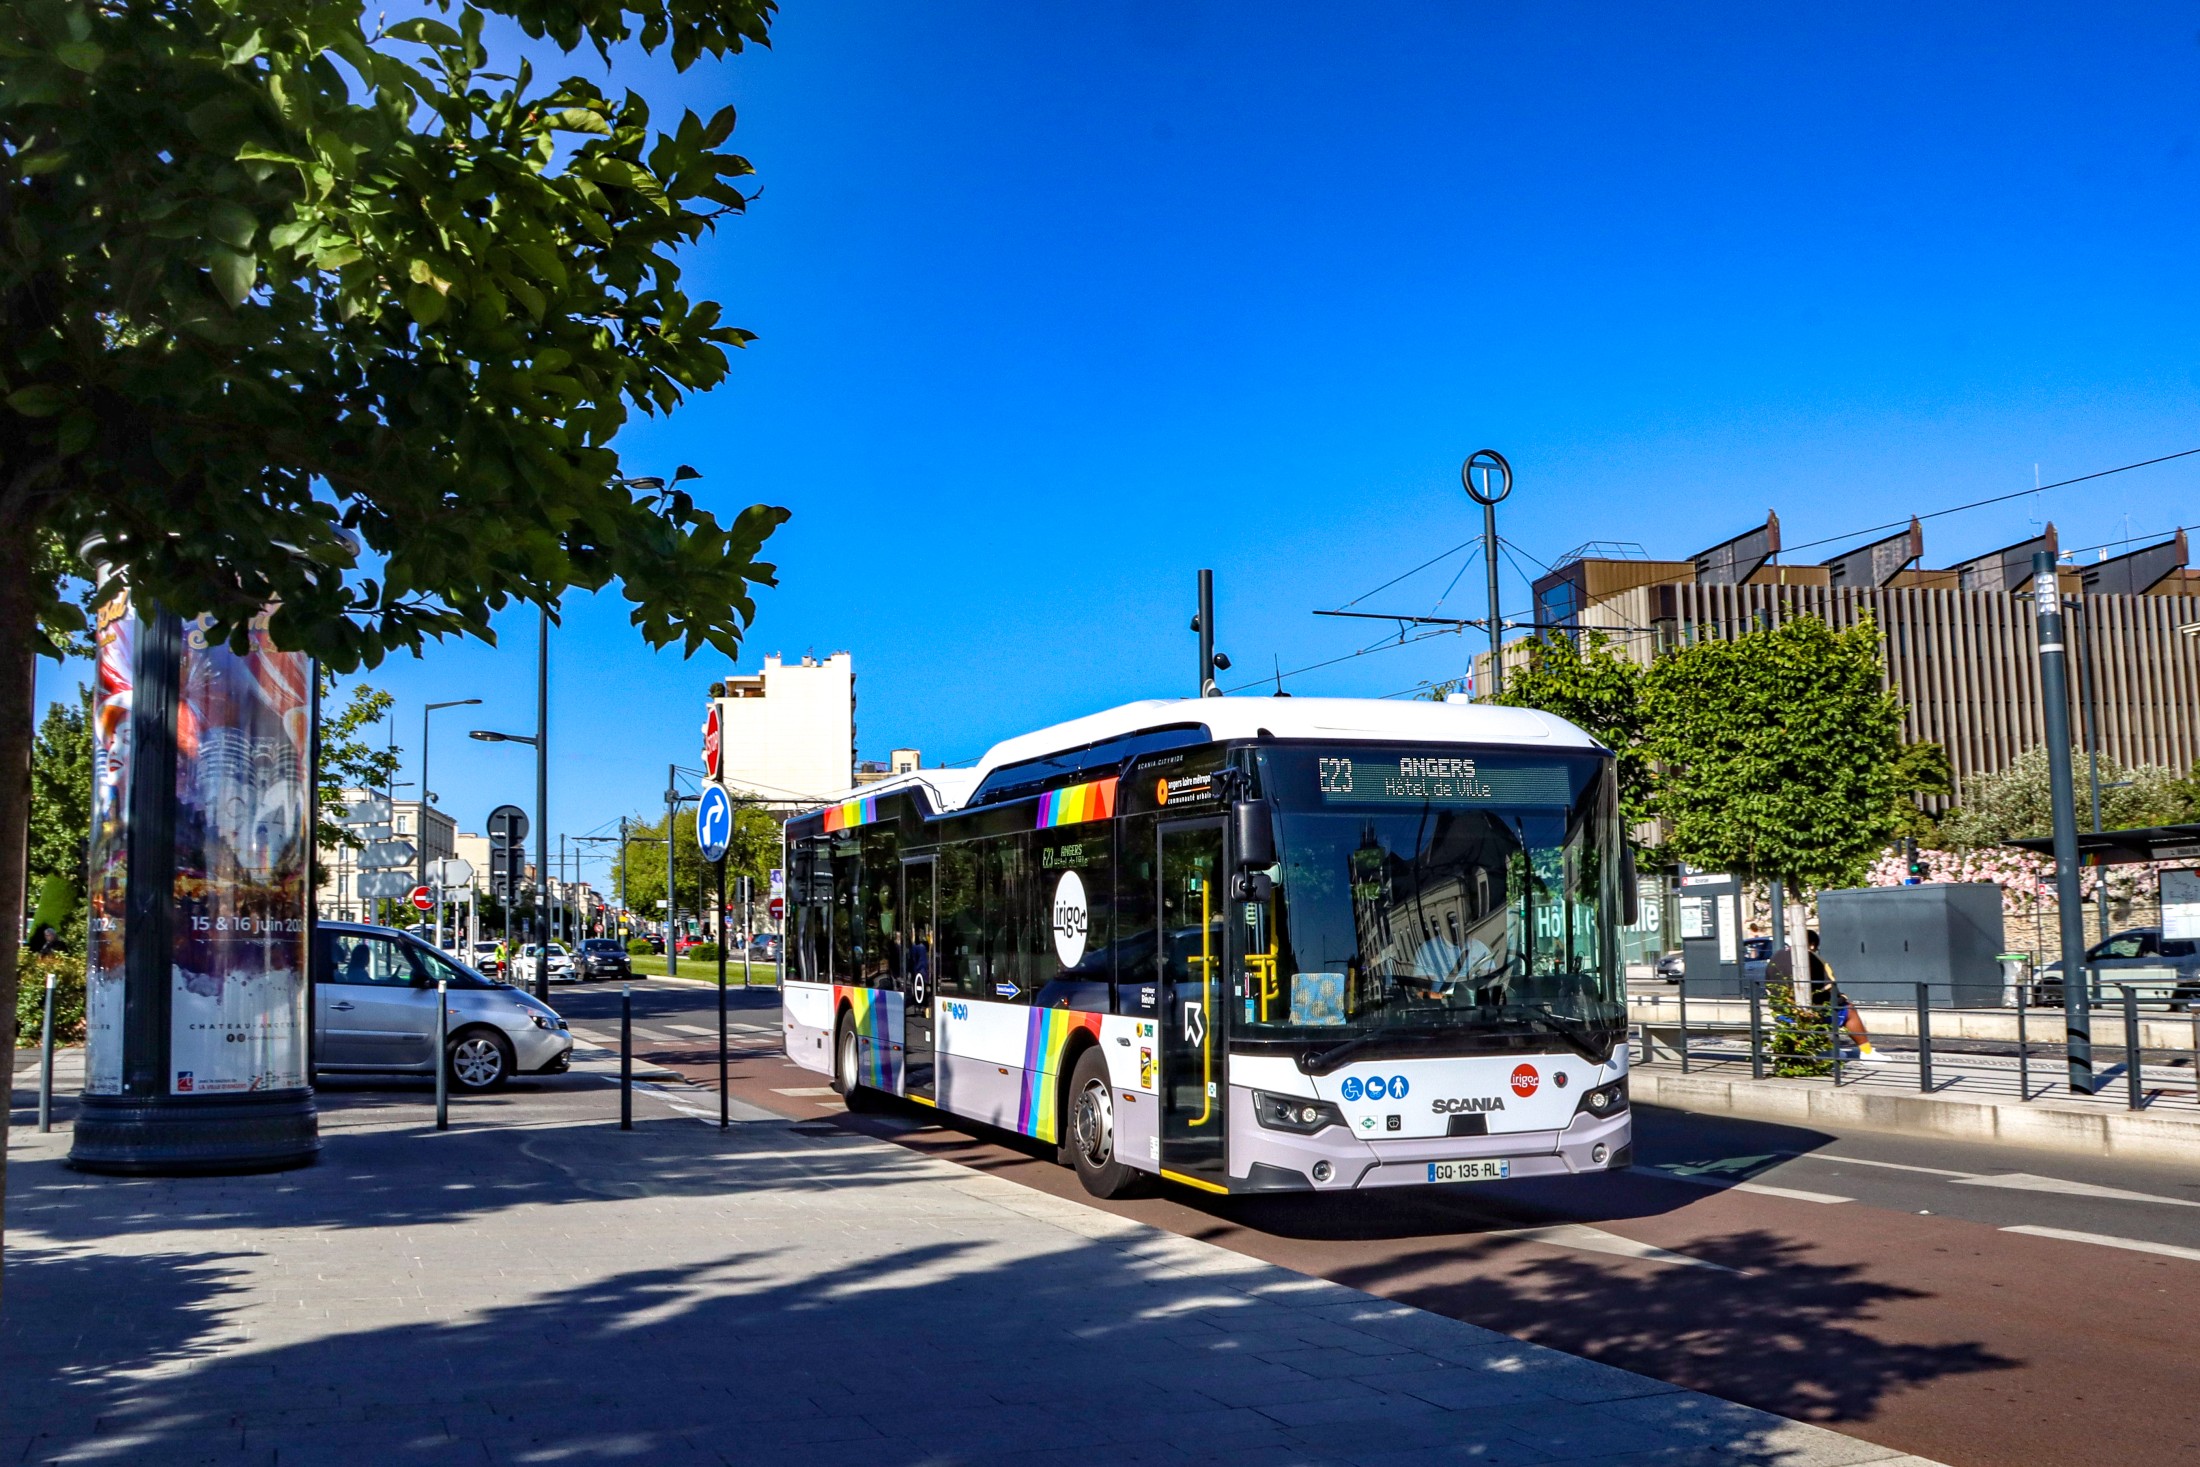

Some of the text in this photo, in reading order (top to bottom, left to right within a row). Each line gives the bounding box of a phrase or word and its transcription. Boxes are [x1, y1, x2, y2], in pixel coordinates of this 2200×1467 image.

[1137, 755, 1184, 770] SCANIA CITYWIDE
[1400, 757, 1476, 778] ANGERS
[1168, 773, 1211, 790] angers loire métropo
[1319, 757, 1353, 792] E23
[1385, 778, 1492, 797] Hôtel de Ville
[1167, 793, 1195, 805] communauté
[1061, 844, 1083, 857] ANGERS
[191, 916, 210, 931] 15
[215, 916, 229, 931] &
[233, 916, 251, 931] 16
[254, 918, 283, 935] juin
[1432, 1097, 1505, 1114] SCANIA
